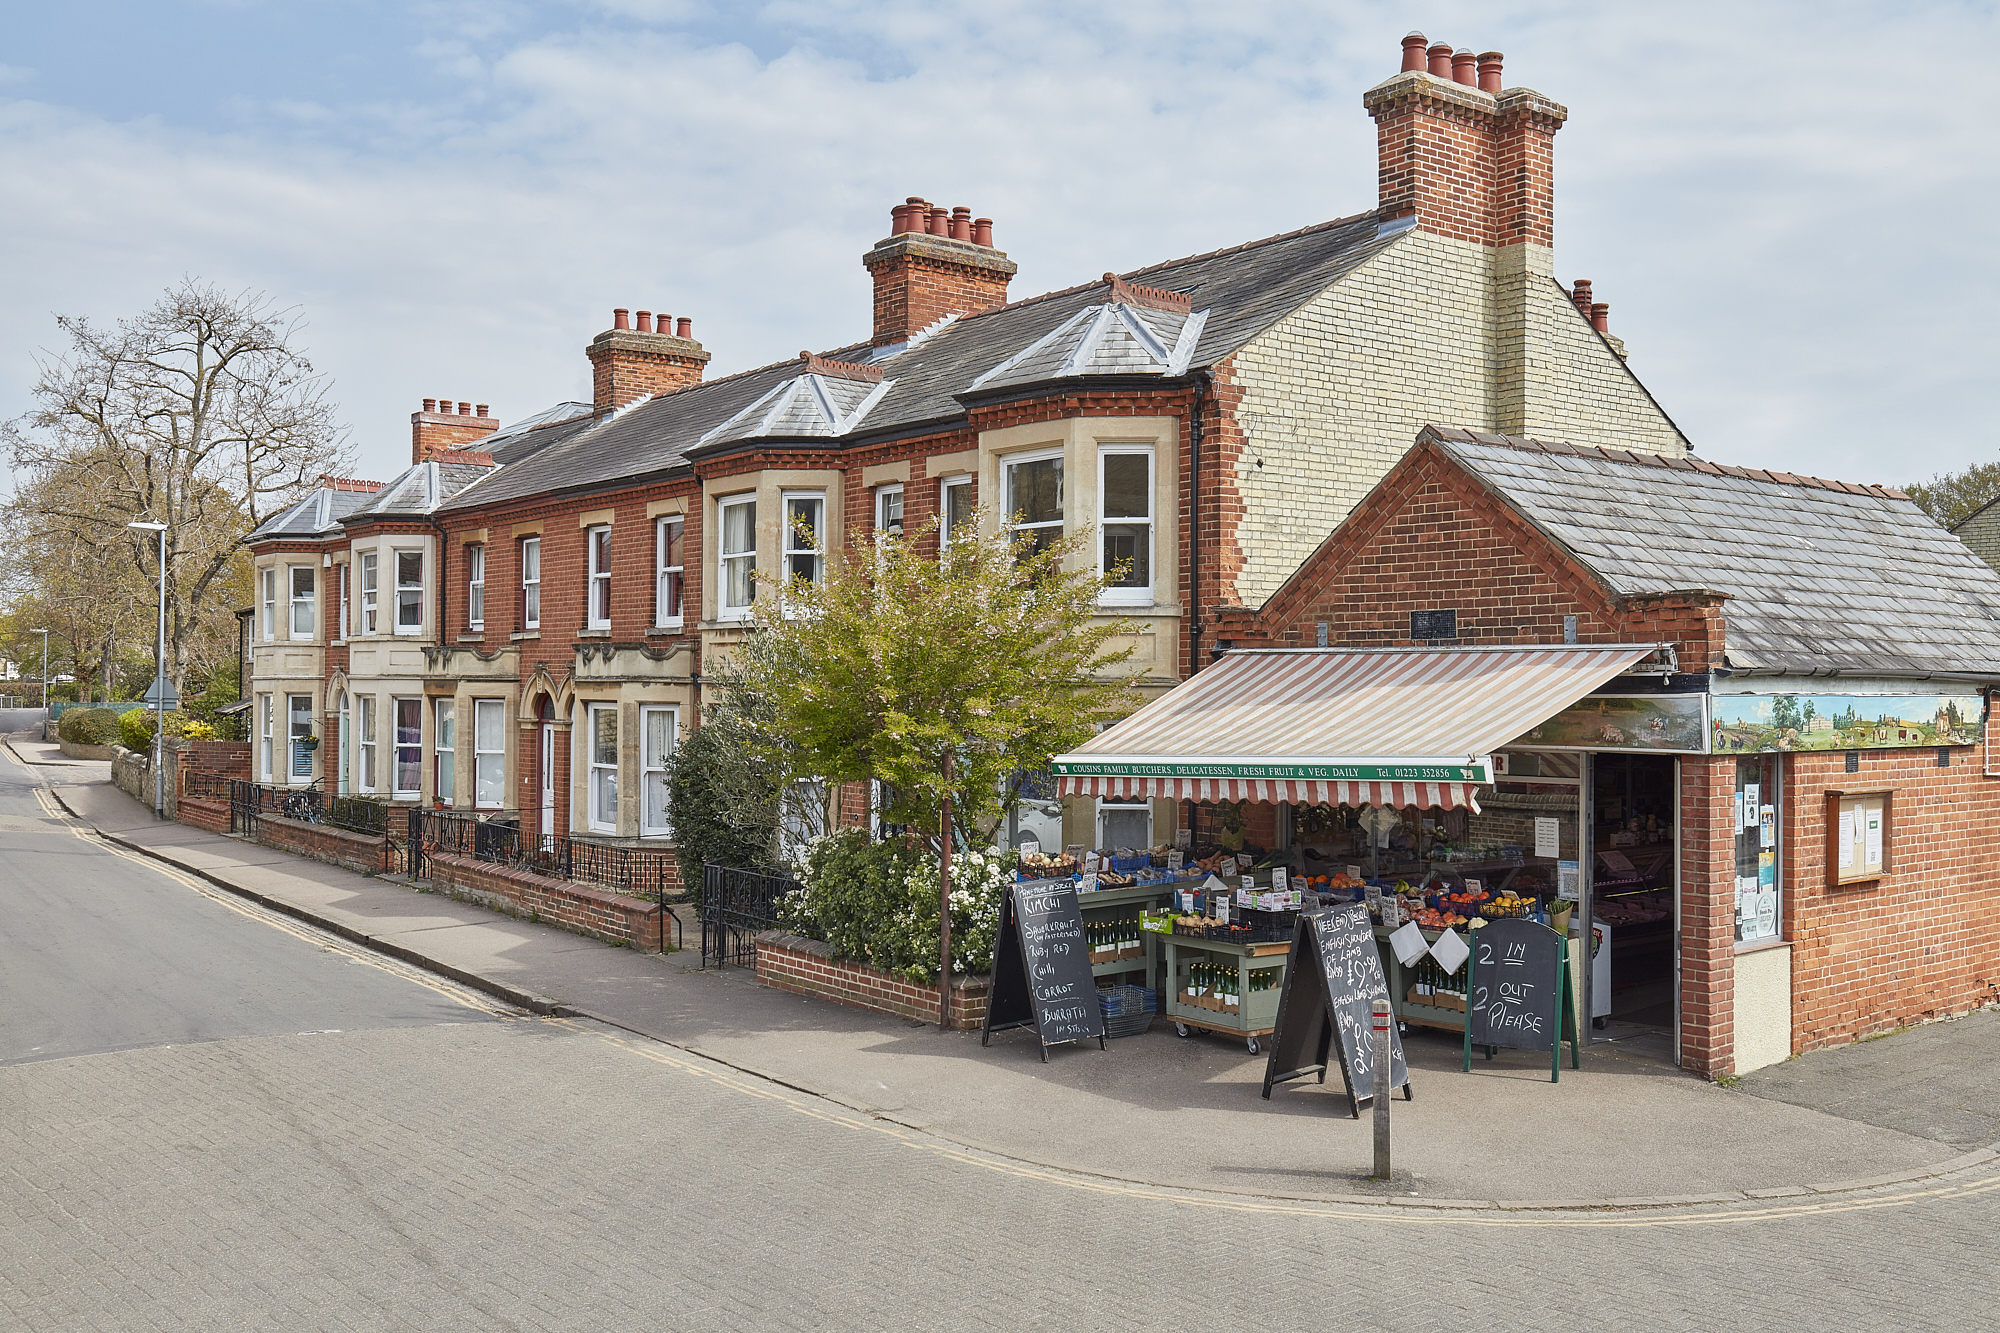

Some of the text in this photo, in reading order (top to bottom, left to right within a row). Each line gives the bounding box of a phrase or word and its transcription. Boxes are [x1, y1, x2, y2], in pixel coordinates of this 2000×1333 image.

[1072, 765, 1359, 777] COUSINS FAMILY BUTCHERS, DELICATESSEN, FRESH FRUIT & VEG. DAILY
[1376, 768, 1450, 778] Tel. 01223 352856
[1023, 897, 1060, 916] KIMCHI
[1024, 919, 1075, 939] SAUERKRAUT
[1316, 913, 1348, 935] WEEKEND
[1346, 909, 1368, 930] SPECIAL
[1028, 943, 1070, 959] RUBY RED
[1320, 929, 1374, 955] ENGLISH SHOULDER
[1326, 946, 1362, 964] OF LAMB
[1478, 942, 1526, 965] 2 IN
[1035, 982, 1074, 1001] CARROT
[1473, 982, 1535, 1011] 2 OUT
[1041, 1006, 1087, 1026] BURRATA
[1056, 1025, 1065, 1035] IN
